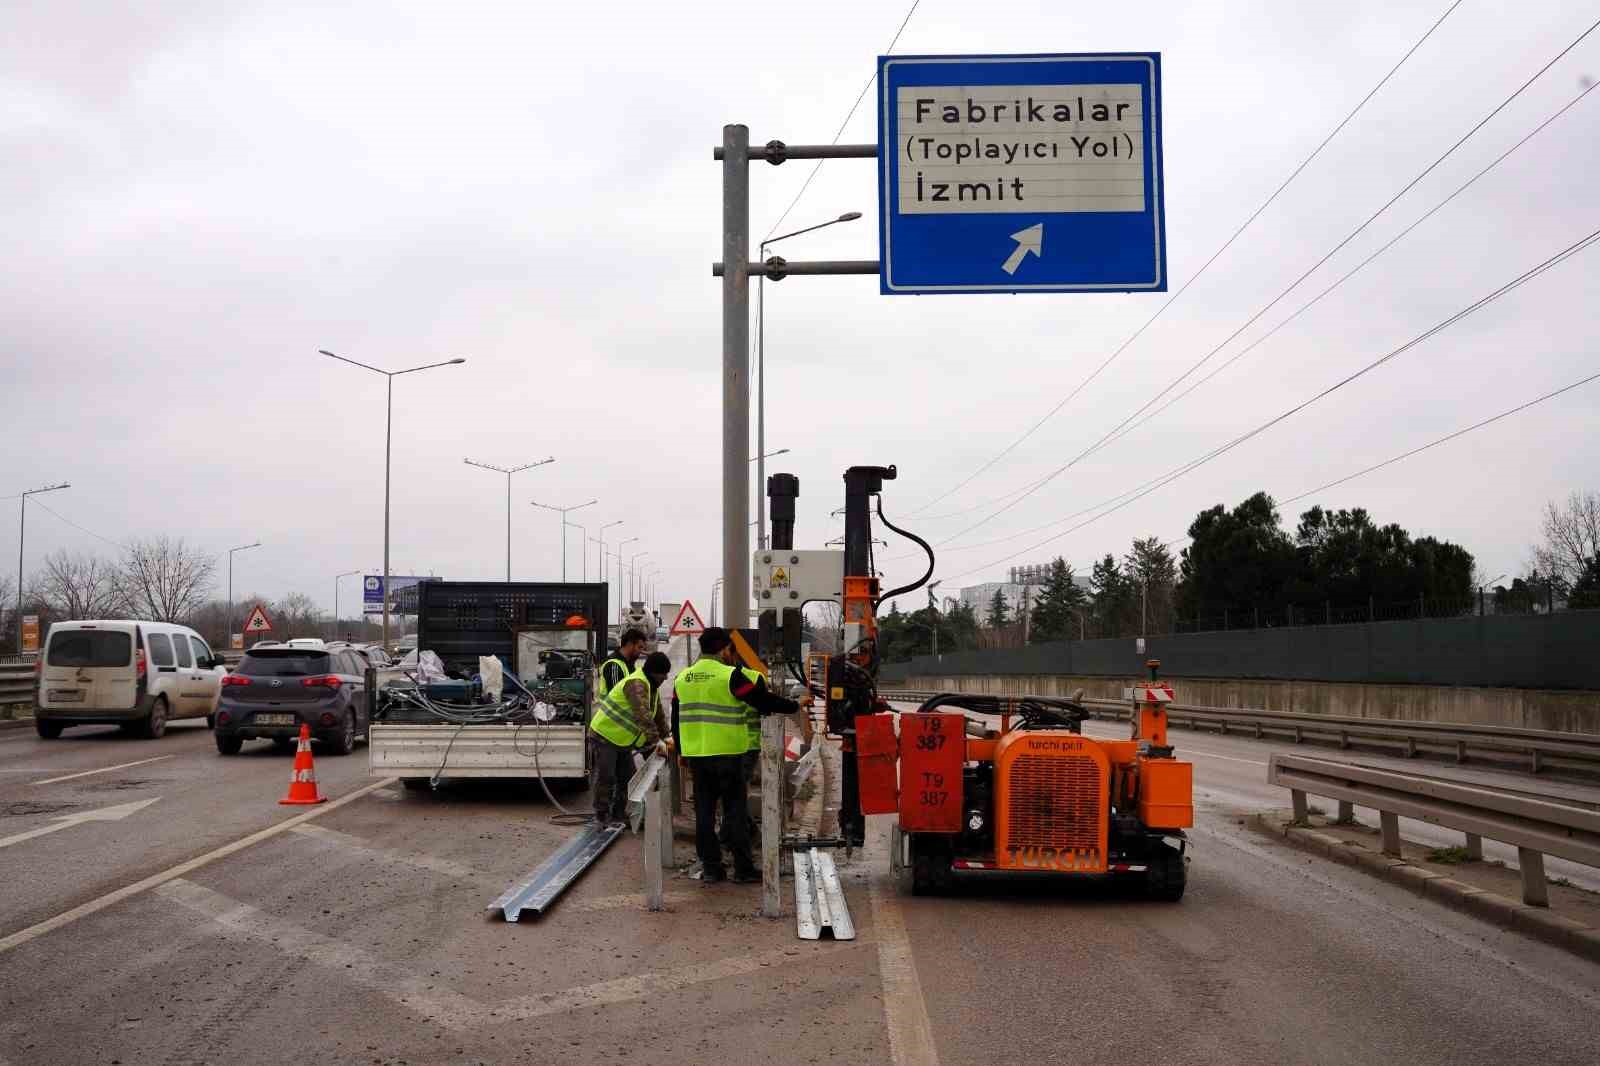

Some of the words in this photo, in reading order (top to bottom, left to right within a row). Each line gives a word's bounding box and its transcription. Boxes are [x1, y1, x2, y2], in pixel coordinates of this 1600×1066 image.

[915, 97, 1130, 123] Fabrikalar
[906, 135, 1058, 164] (Toplayıcı
[1070, 133, 1133, 160] Yol)
[916, 171, 1025, 202] İzmit
[921, 717, 942, 732] T9
[916, 734, 947, 750] 387
[921, 772, 944, 788] T9
[920, 791, 949, 806] 387
